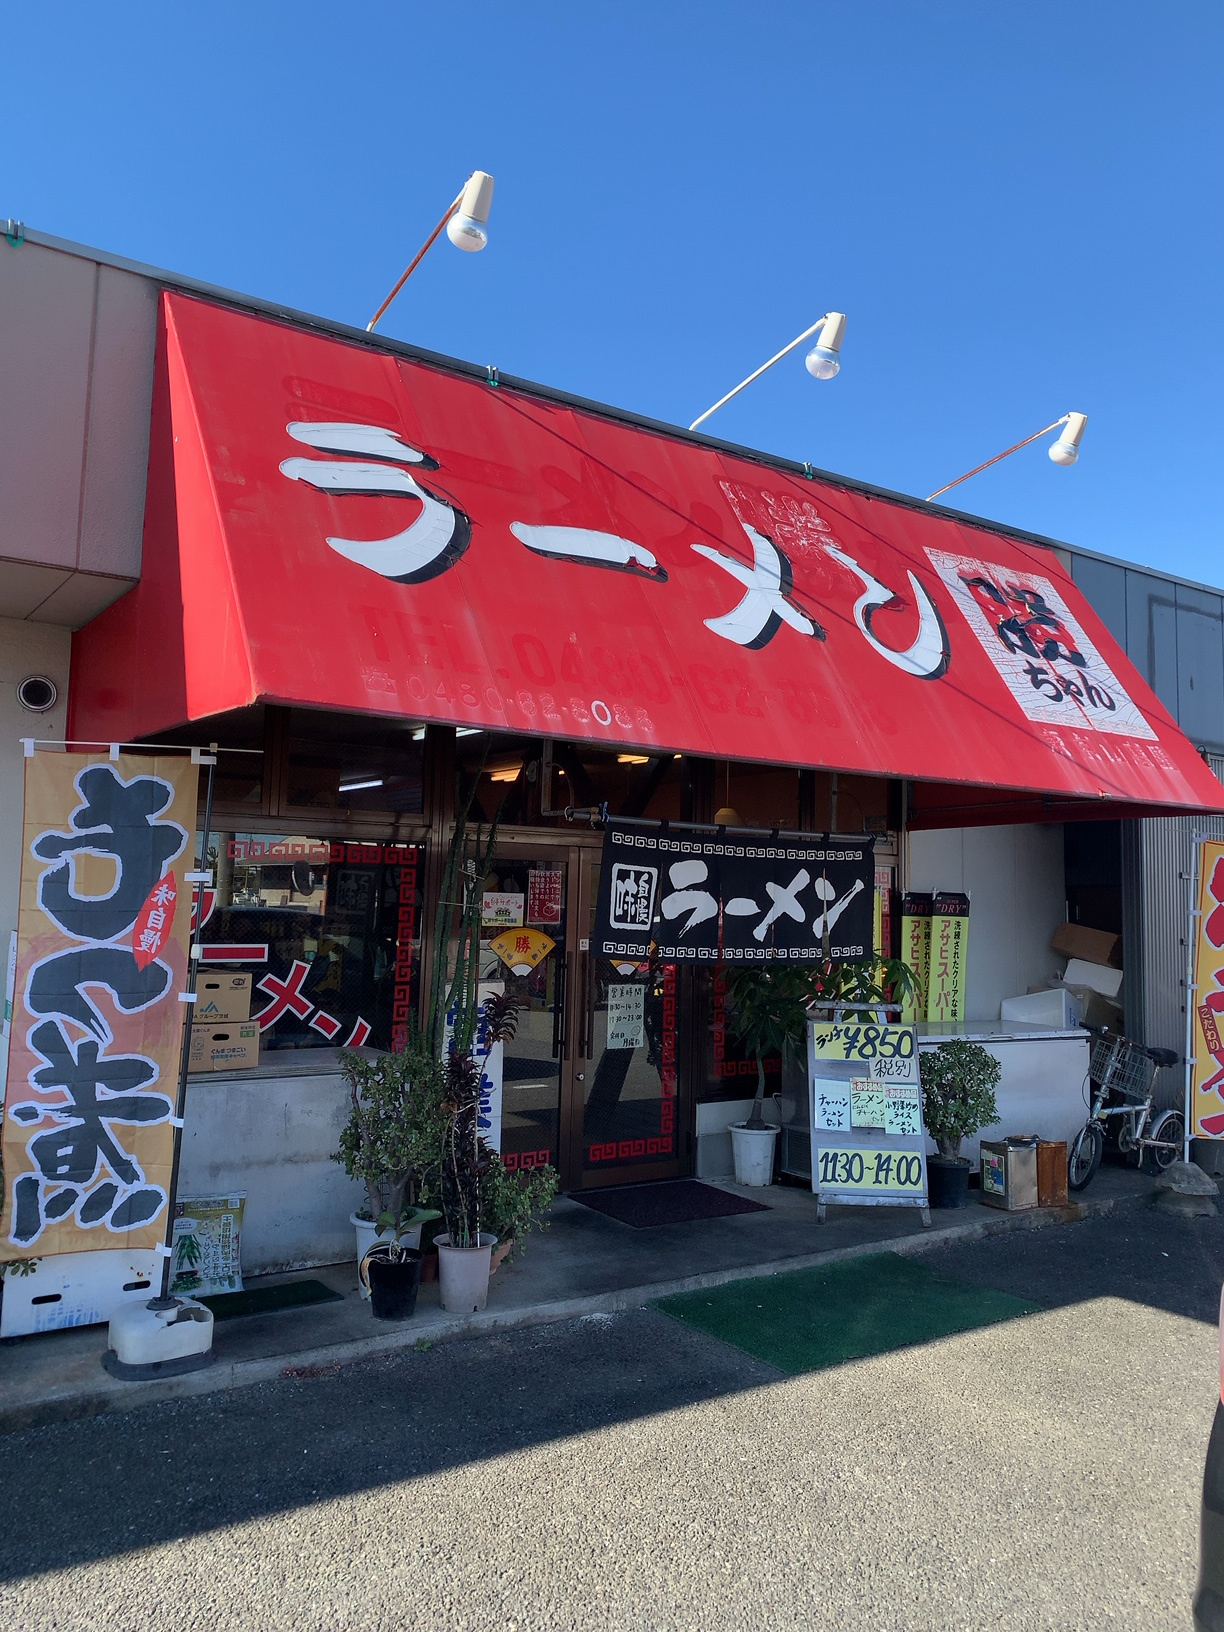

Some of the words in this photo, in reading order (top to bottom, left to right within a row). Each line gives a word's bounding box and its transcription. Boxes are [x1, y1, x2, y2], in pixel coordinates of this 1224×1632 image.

[279, 421, 952, 682] ラーメン
[1022, 659, 1117, 712] ちゃん
[661, 859, 865, 942] ラーメン
[514, 935, 532, 954] 勝
[935, 920, 951, 1021] アサヒスーパー
[1200, 1007, 1220, 1051] こだわり
[816, 1025, 844, 1050] ランチ
[843, 1026, 914, 1060] ¥850
[873, 1058, 912, 1078] 税別
[818, 1093, 849, 1107] チャーハン
[851, 1092, 884, 1105] ラーメン
[821, 1108, 845, 1118] ラーメン
[893, 1112, 913, 1120] ライス
[825, 1119, 844, 1128] セット
[888, 1119, 912, 1127] ラーメン
[900, 1126, 918, 1135] セット
